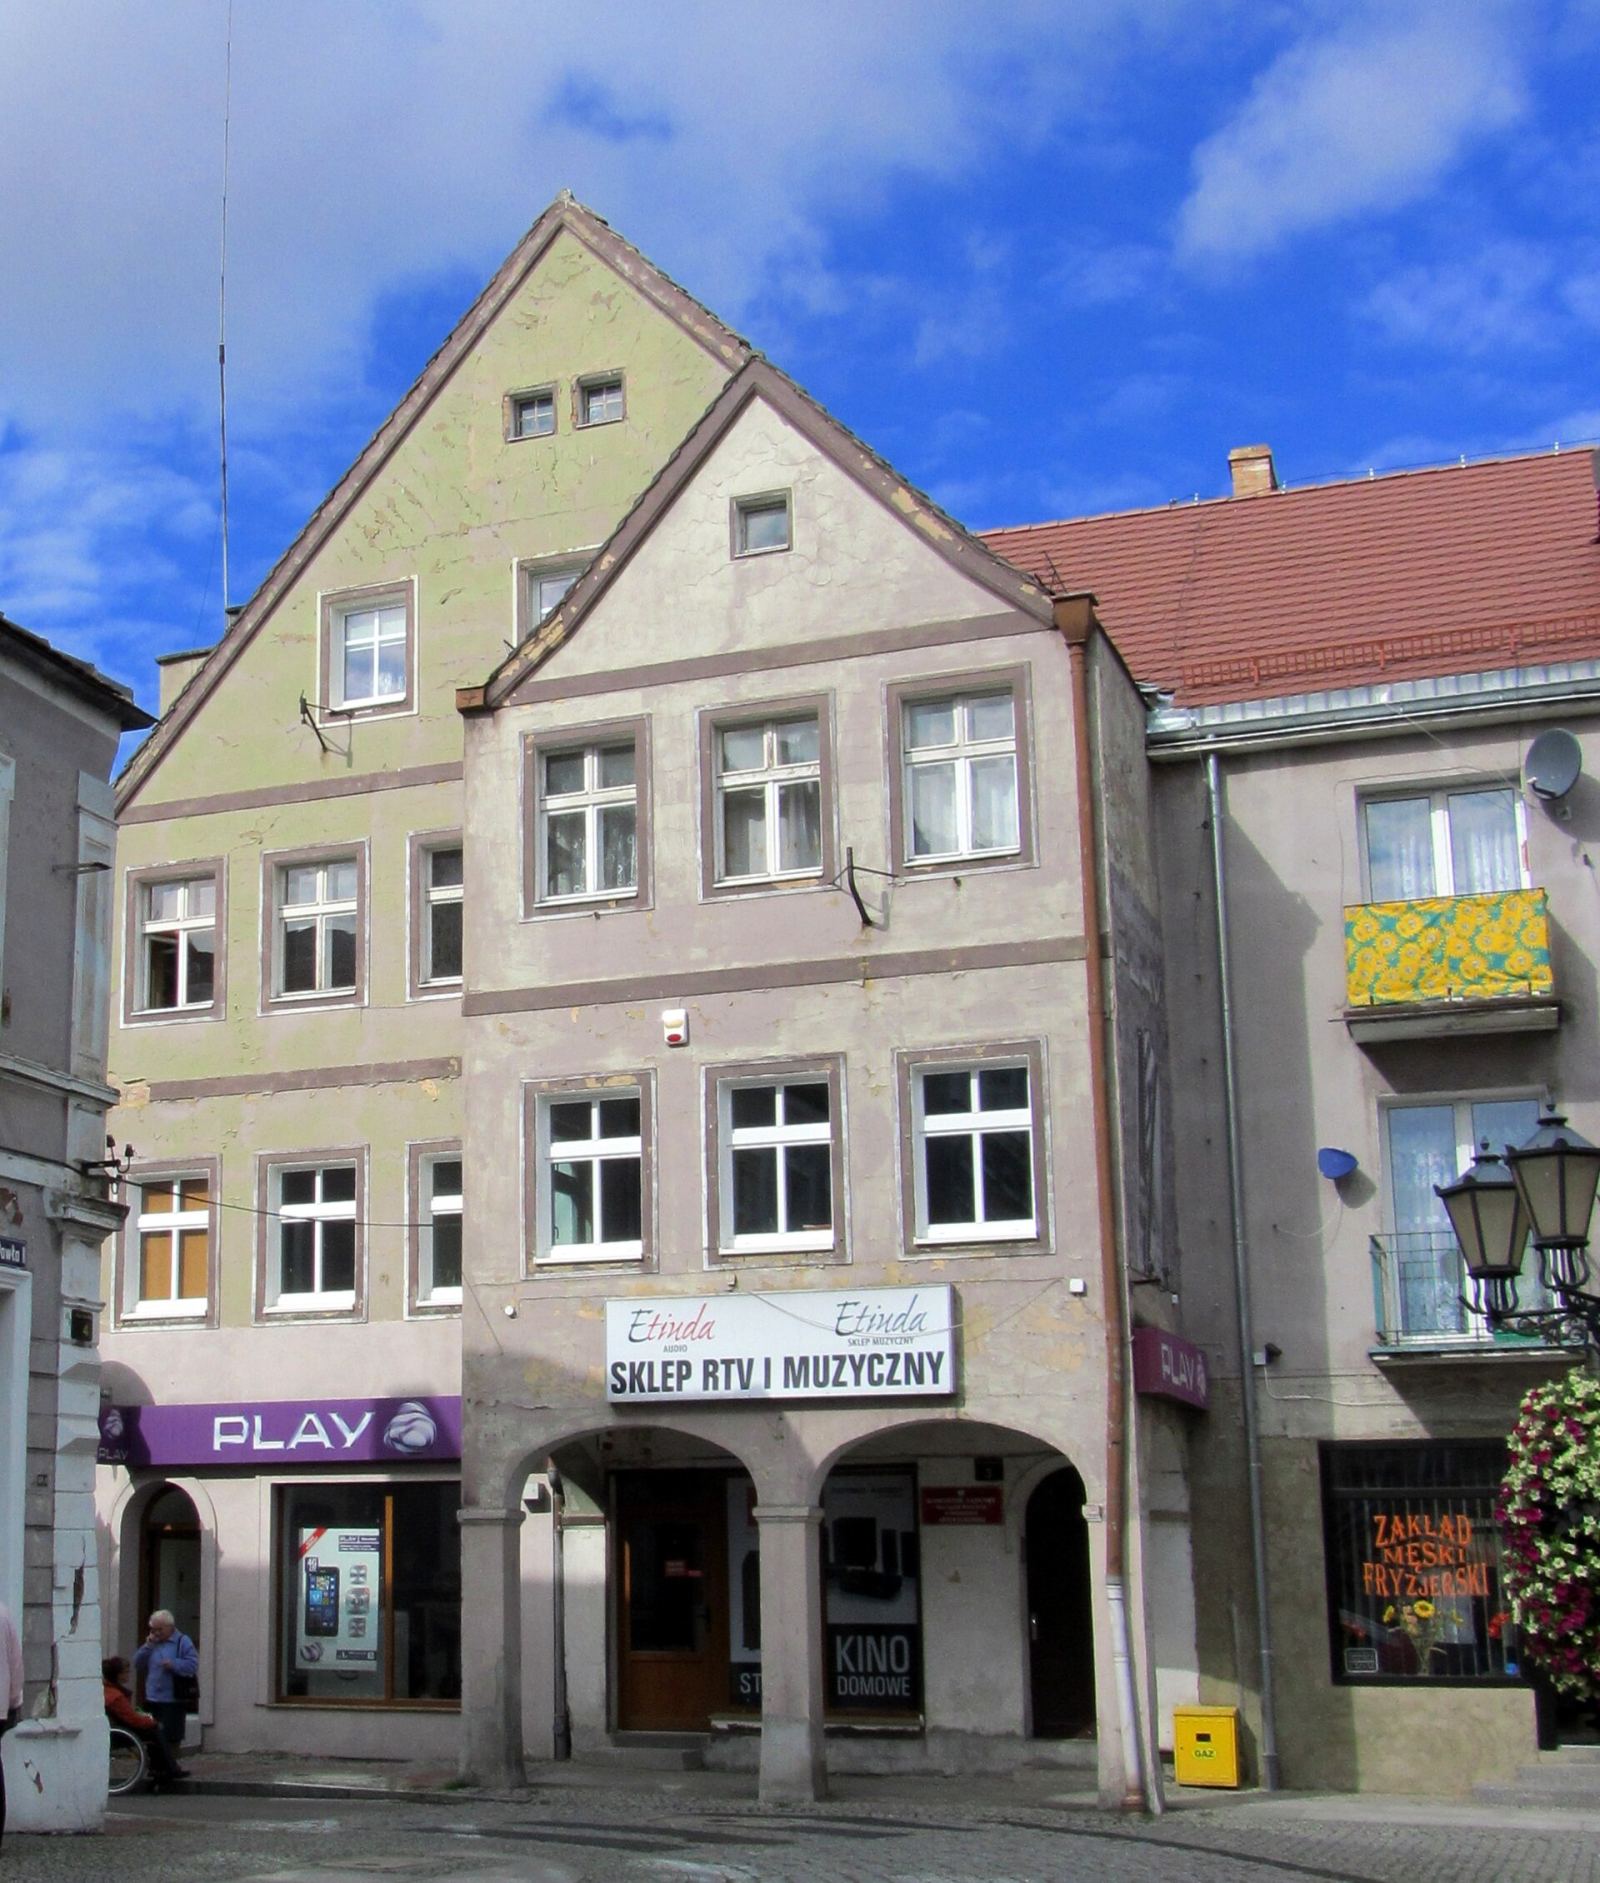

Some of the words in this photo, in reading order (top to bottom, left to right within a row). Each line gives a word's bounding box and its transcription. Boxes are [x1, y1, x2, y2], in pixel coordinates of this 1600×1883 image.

[663, 1344, 688, 1353] AUDIO
[848, 1337, 870, 1347] SKLEP
[872, 1336, 915, 1346] MUZYCZNY
[611, 1359, 692, 1395] SKLEP
[702, 1357, 755, 1392] RTV
[764, 1356, 771, 1390] I
[783, 1350, 945, 1389] MUZYCZNY
[1161, 1343, 1194, 1392] PLAY
[213, 1411, 375, 1451] PLAY
[98, 1447, 128, 1460] PLAY
[1363, 1562, 1490, 1597] FRYZJERSKI
[836, 1635, 911, 1674] KINO
[740, 1672, 761, 1694] ST
[837, 1675, 911, 1697] DOMOWE
[1194, 1750, 1214, 1758] GAZ
